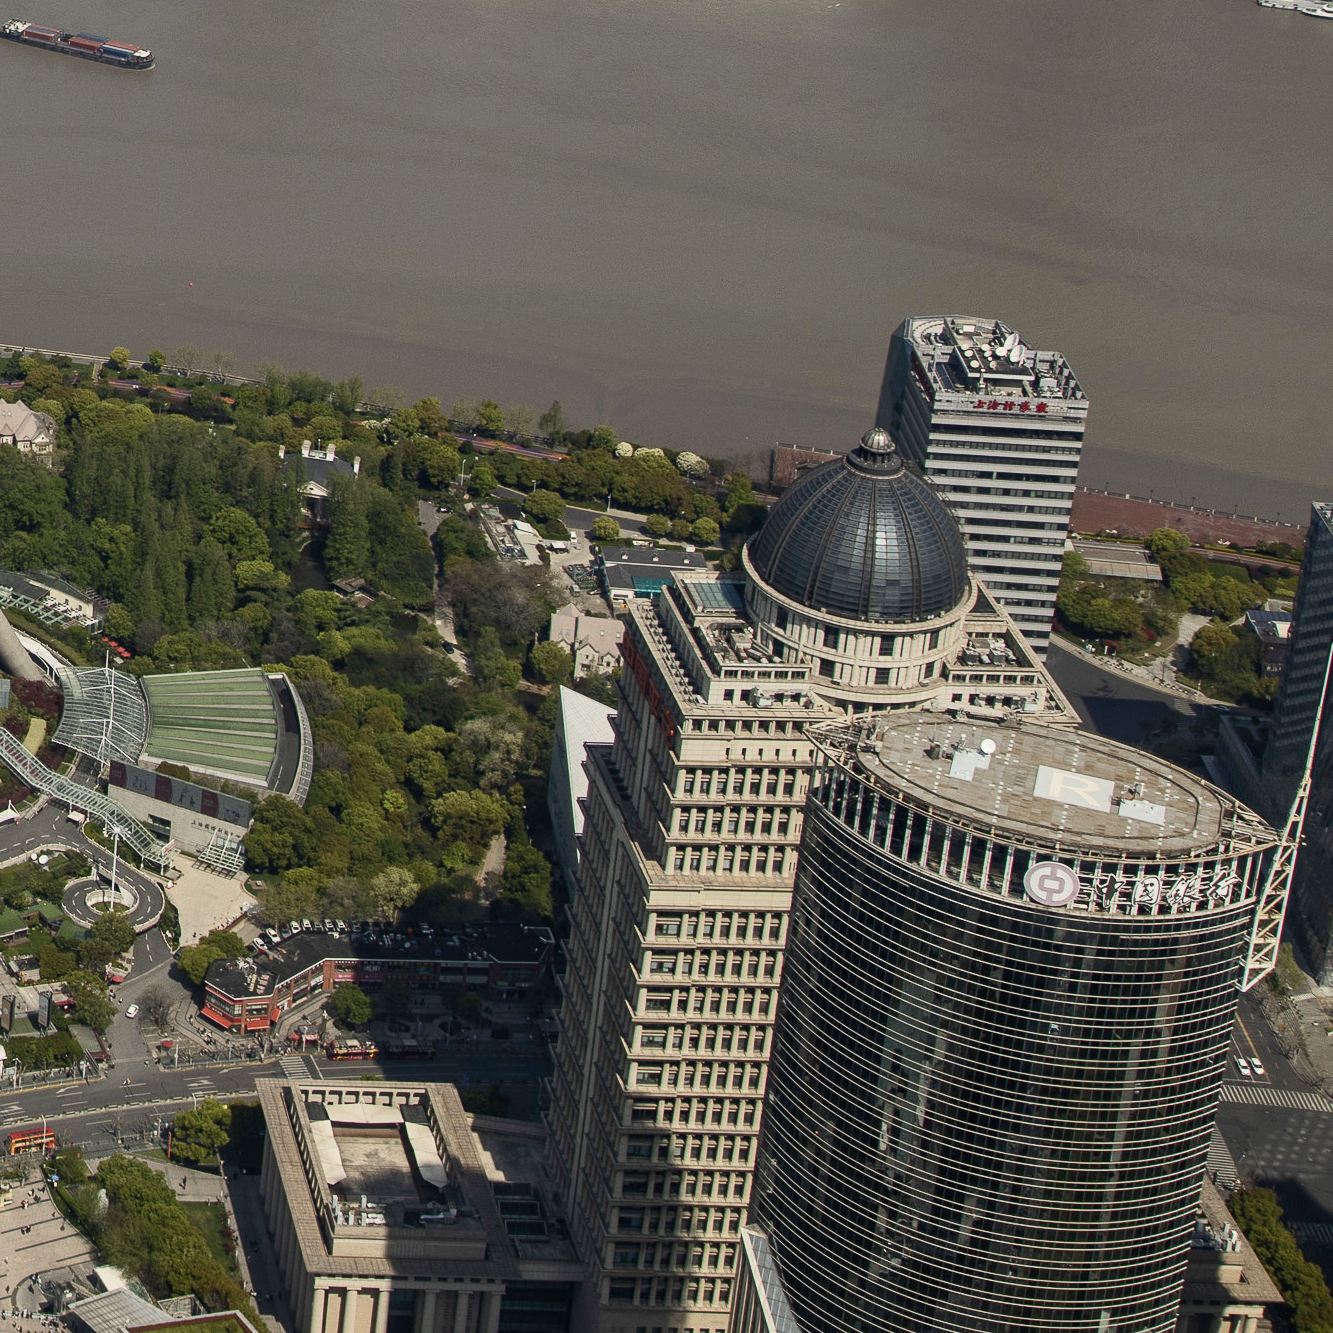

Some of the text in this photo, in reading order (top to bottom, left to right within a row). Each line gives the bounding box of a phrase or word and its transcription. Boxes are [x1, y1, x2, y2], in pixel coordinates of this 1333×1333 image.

[1049, 772, 1103, 807] R
[1095, 870, 1243, 908] 中国银行
